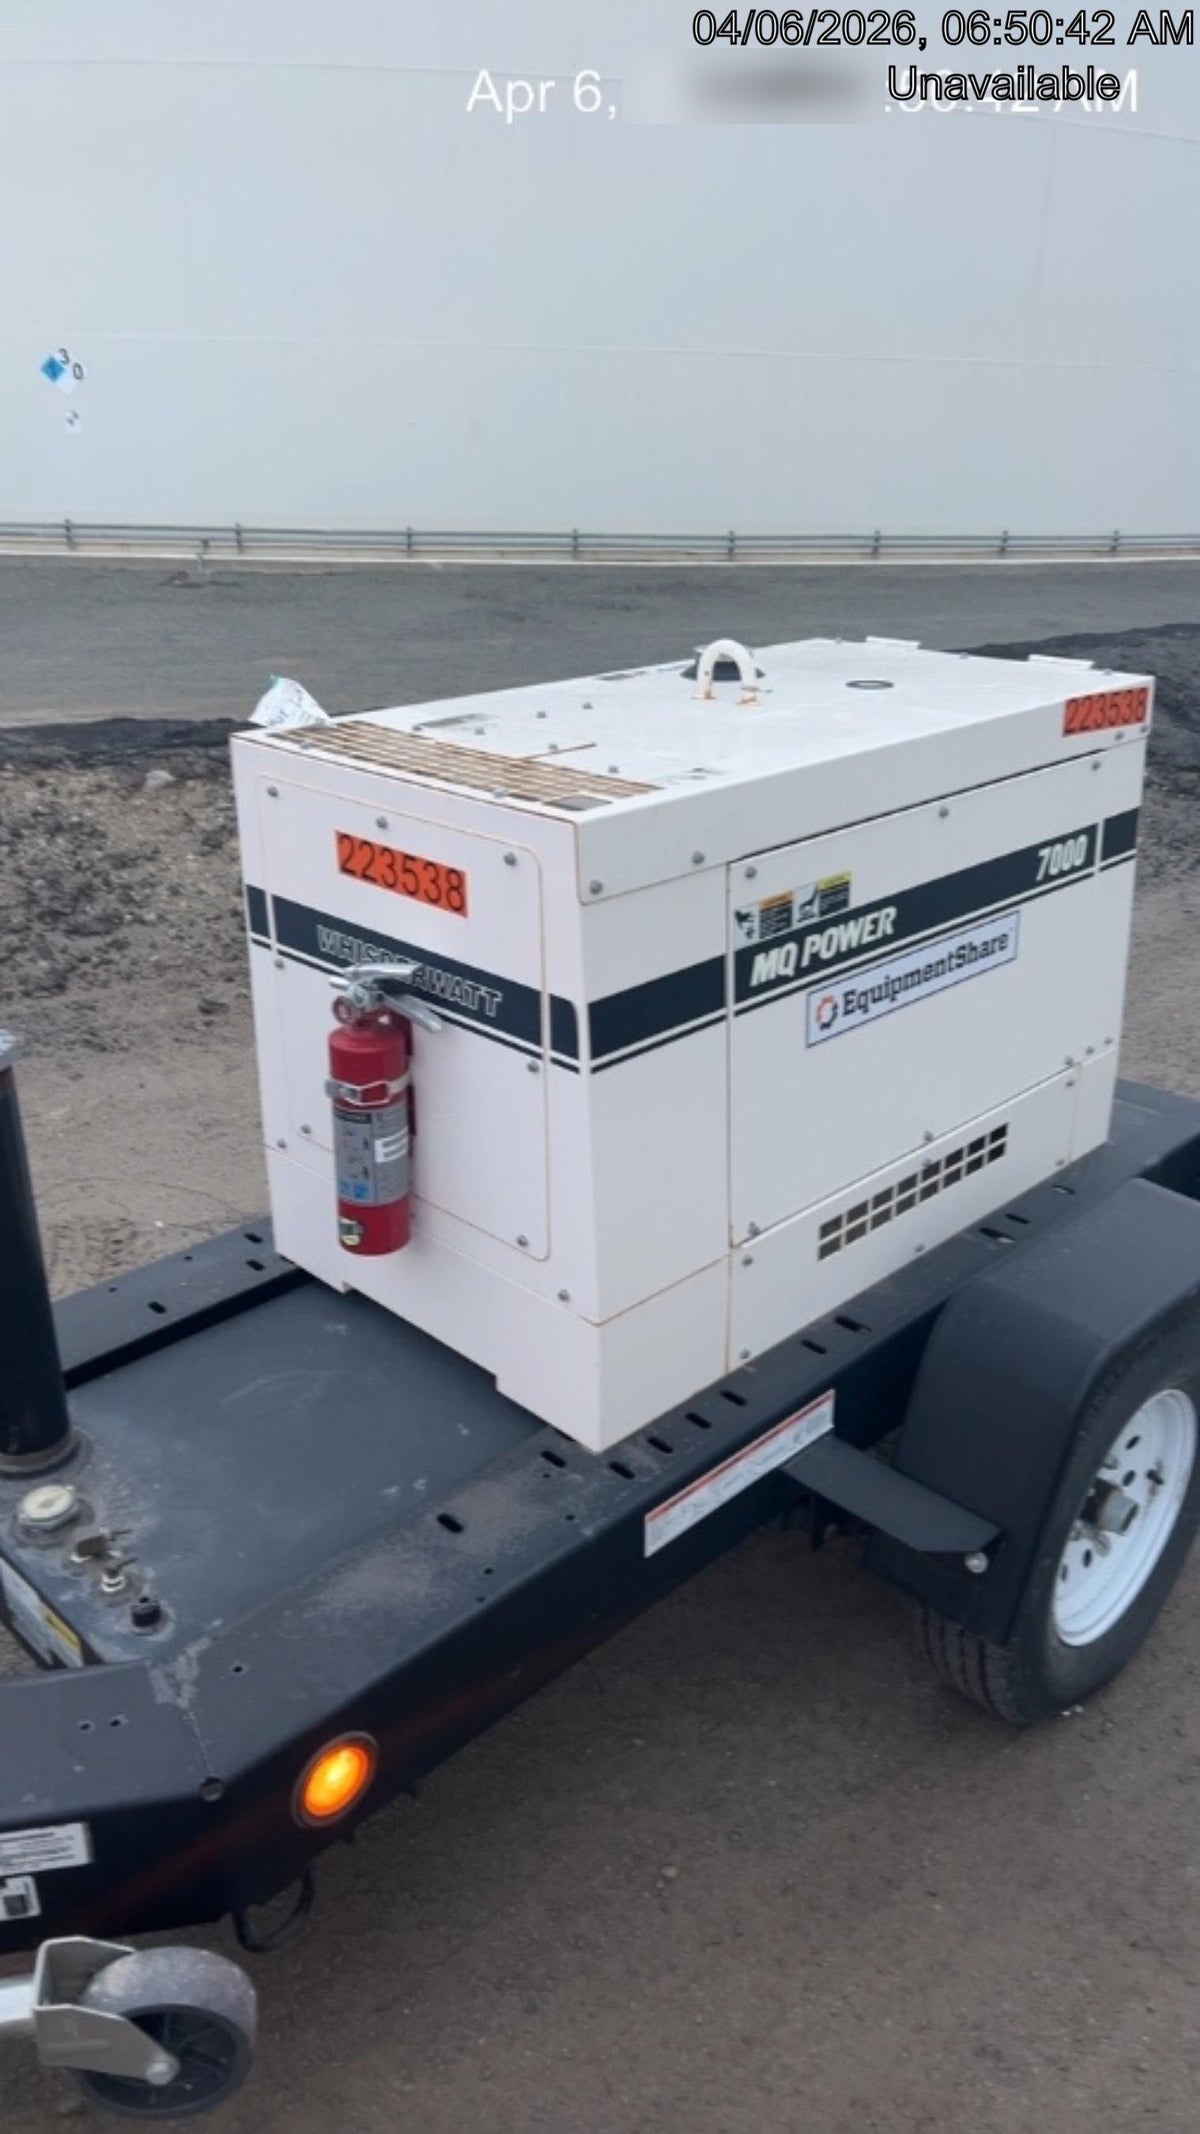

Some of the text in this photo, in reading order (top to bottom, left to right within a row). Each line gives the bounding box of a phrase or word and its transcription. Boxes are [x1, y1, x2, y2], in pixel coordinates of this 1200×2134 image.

[1064, 687, 1148, 734] 223538
[338, 833, 466, 912] 223538
[1035, 834, 1088, 881] 7000
[750, 941, 799, 987] MQ
[801, 907, 897, 968] POWER
[841, 932, 1009, 1016] EquipmentShare
